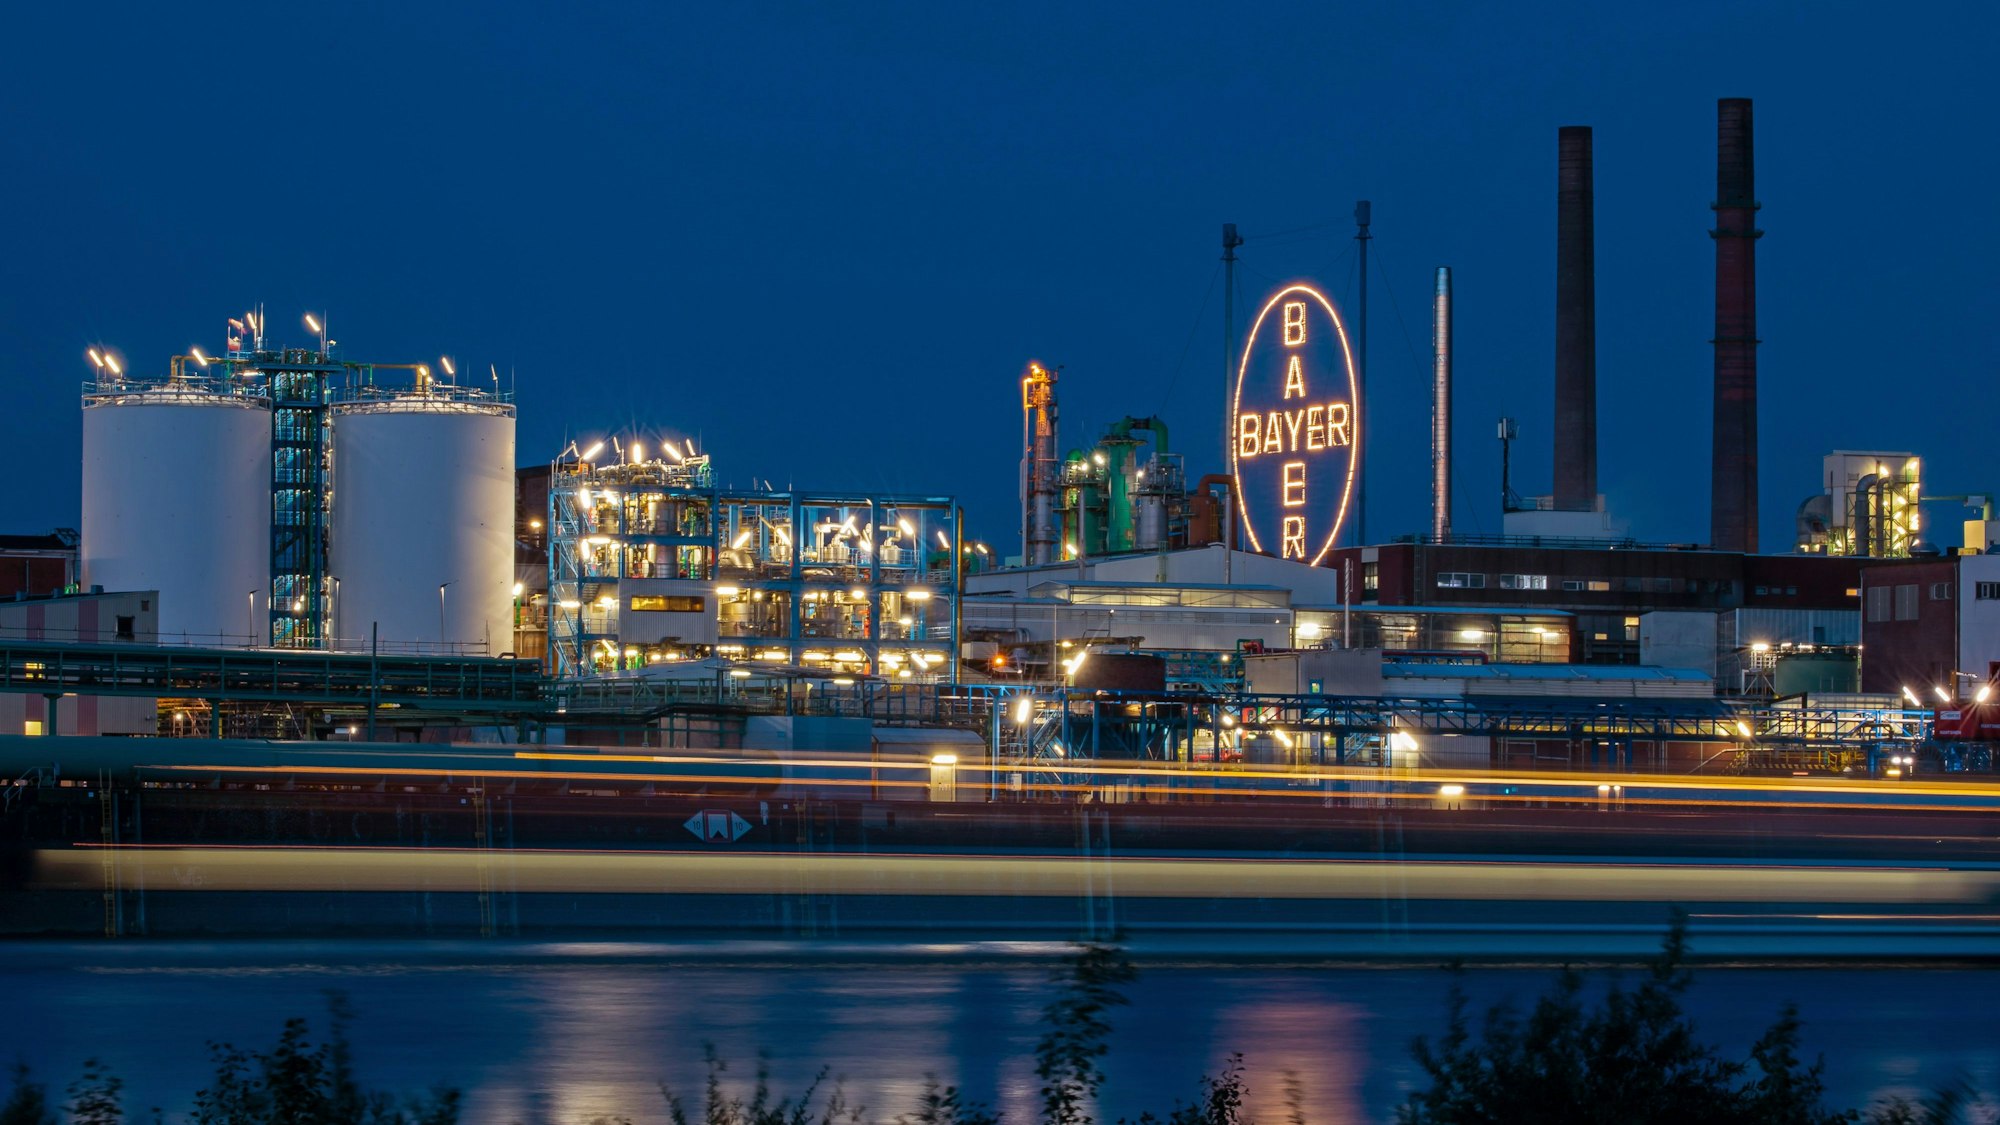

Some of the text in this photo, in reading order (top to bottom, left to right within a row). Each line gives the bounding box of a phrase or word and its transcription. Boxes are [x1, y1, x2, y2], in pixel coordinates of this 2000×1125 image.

[1239, 403, 1350, 457] BAYER
[1283, 302, 1306, 559] BAYER
[693, 821, 701, 831] 10
[735, 822, 743, 831] 10
